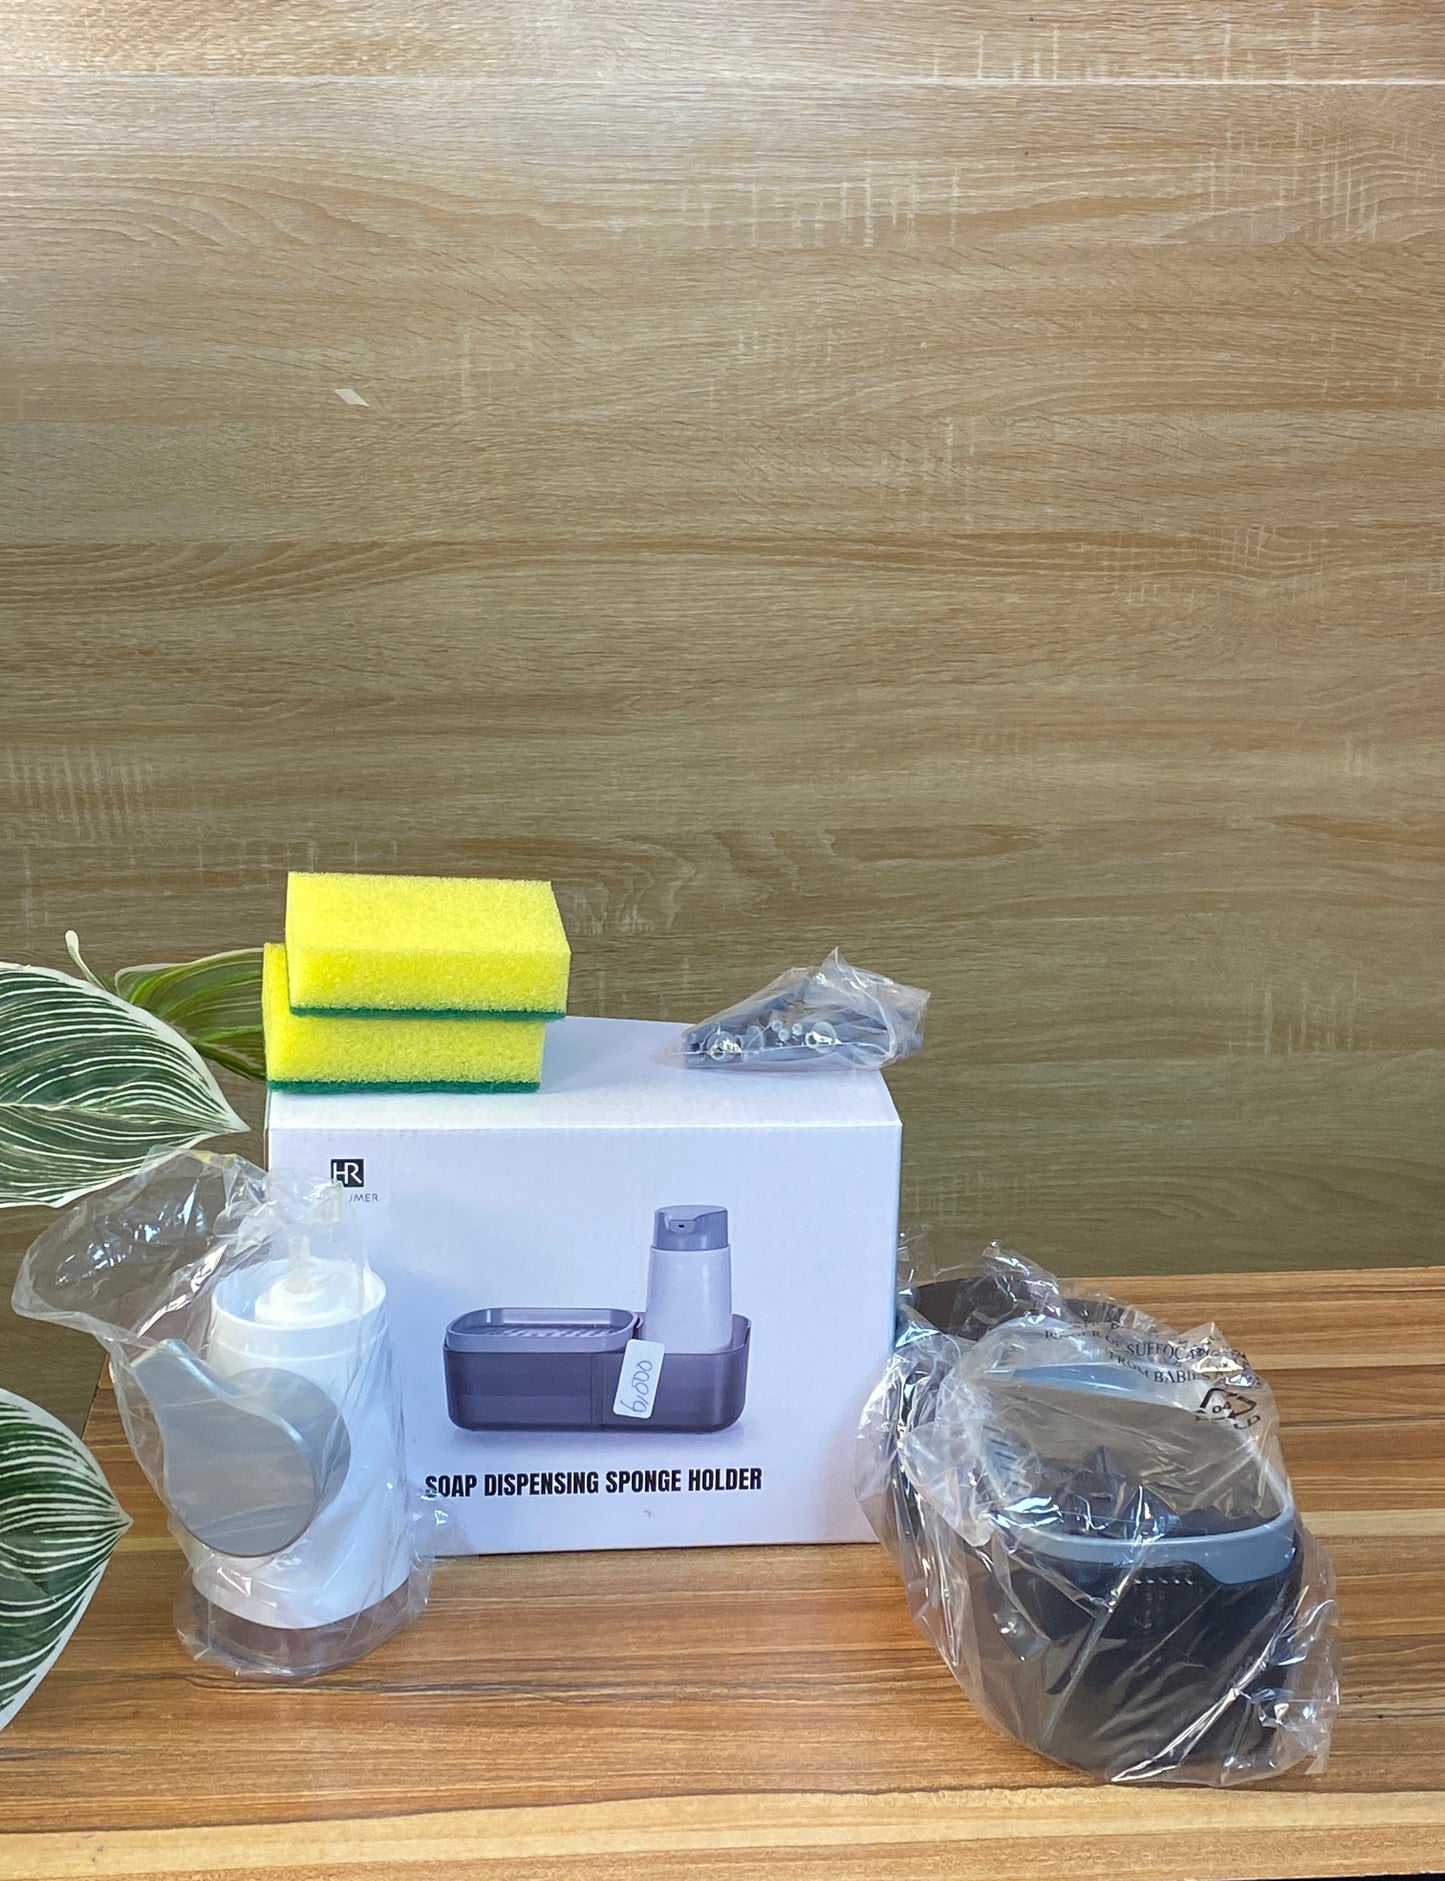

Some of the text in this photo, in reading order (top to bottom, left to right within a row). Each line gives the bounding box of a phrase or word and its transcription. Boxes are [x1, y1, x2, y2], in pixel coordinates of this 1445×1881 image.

[332, 1160, 363, 1186] HR
[425, 1467, 762, 1498] SOAP DISPENSING SPONGE HOLDER
